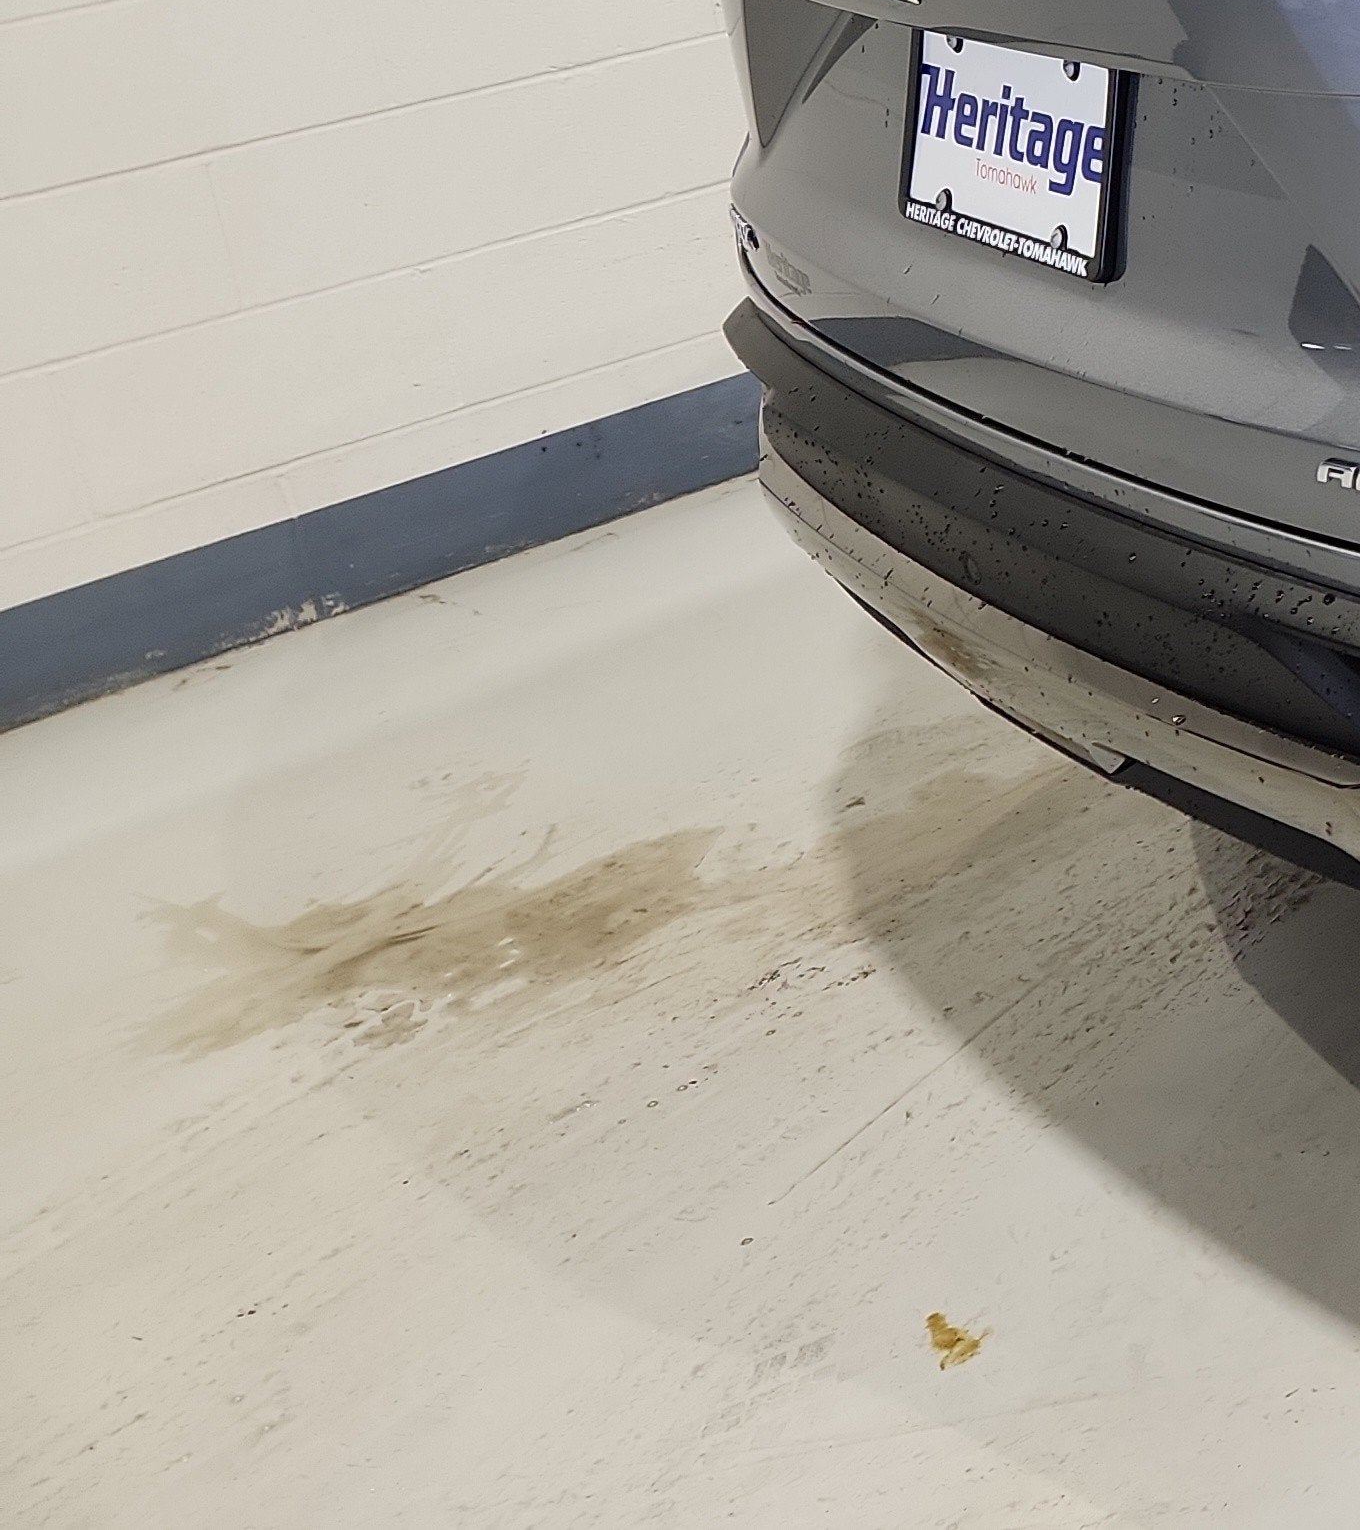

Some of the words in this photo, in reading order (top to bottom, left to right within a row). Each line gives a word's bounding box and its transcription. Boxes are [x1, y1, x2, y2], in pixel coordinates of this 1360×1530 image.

[921, 63, 1106, 196] Heritage
[975, 158, 1038, 195] Tomahawk
[906, 201, 956, 231] HERITAGE
